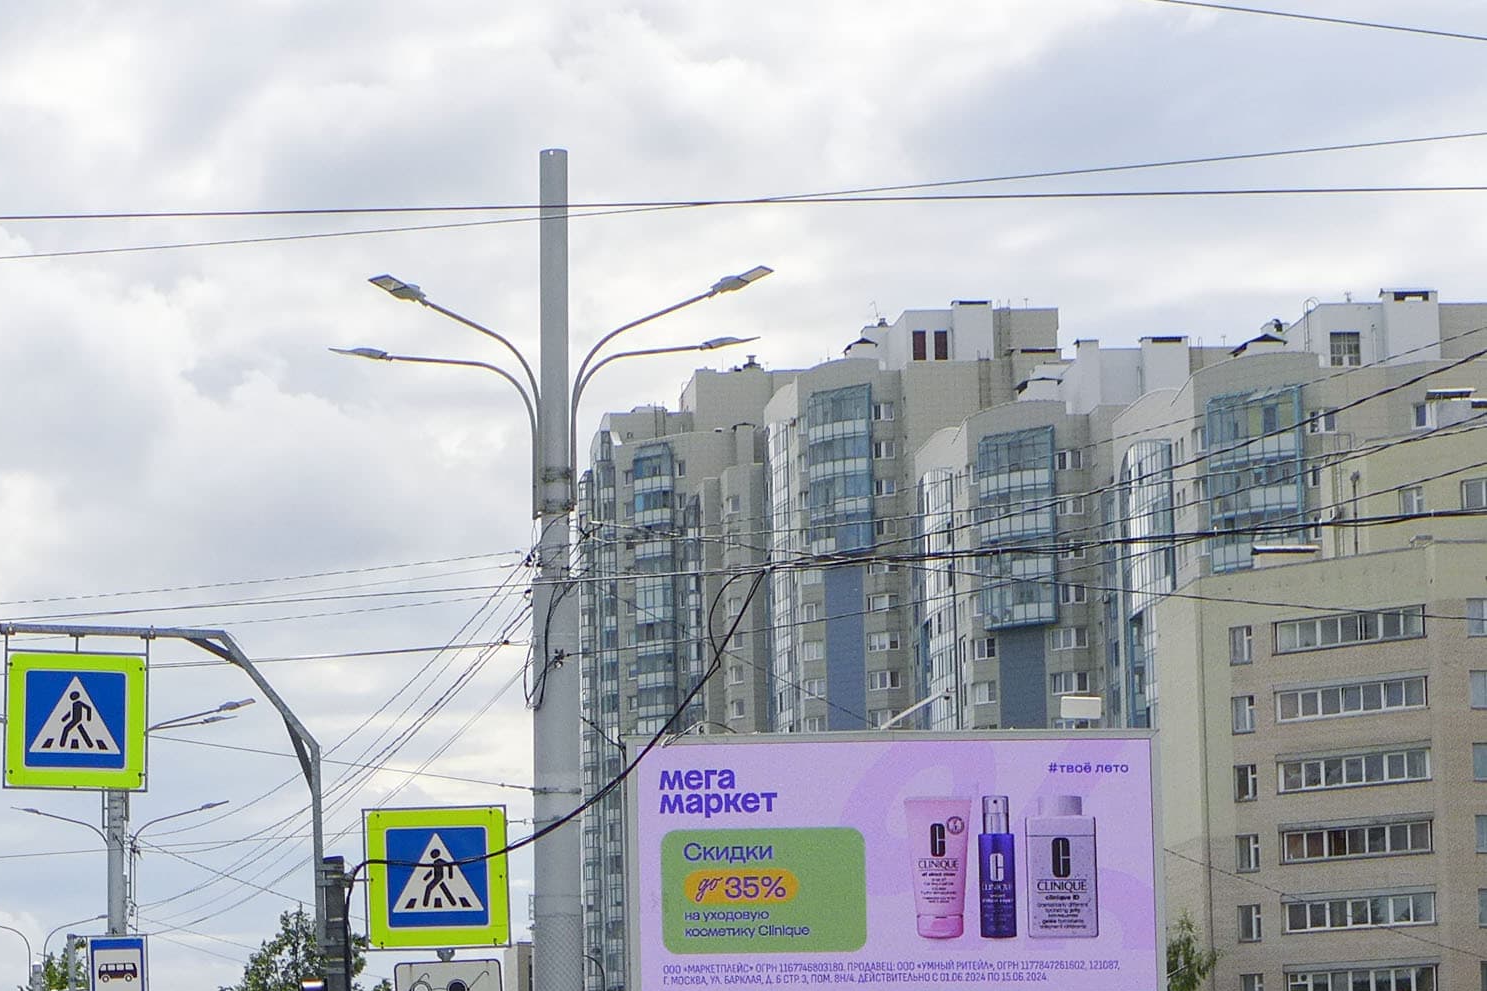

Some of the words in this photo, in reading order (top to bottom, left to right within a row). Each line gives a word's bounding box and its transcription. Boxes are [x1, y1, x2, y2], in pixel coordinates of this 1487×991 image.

[1049, 762, 1091, 773] #твоё
[1095, 764, 1129, 773] лето
[659, 769, 735, 790] мега
[659, 792, 777, 818] маркет
[683, 842, 773, 863] Скидки
[918, 860, 959, 870] CLINIQUE
[695, 876, 722, 902] до
[725, 876, 787, 898] 35%
[1037, 881, 1087, 892] CLINIQUE
[684, 912, 700, 921] на
[703, 910, 769, 922] уходовую
[685, 927, 755, 938] косметику
[758, 924, 810, 937] Clinique
[663, 965, 681, 974] ООО
[755, 963, 777, 973] ОГРН
[897, 961, 914, 971] ООО
[997, 961, 1019, 970] ОГРН
